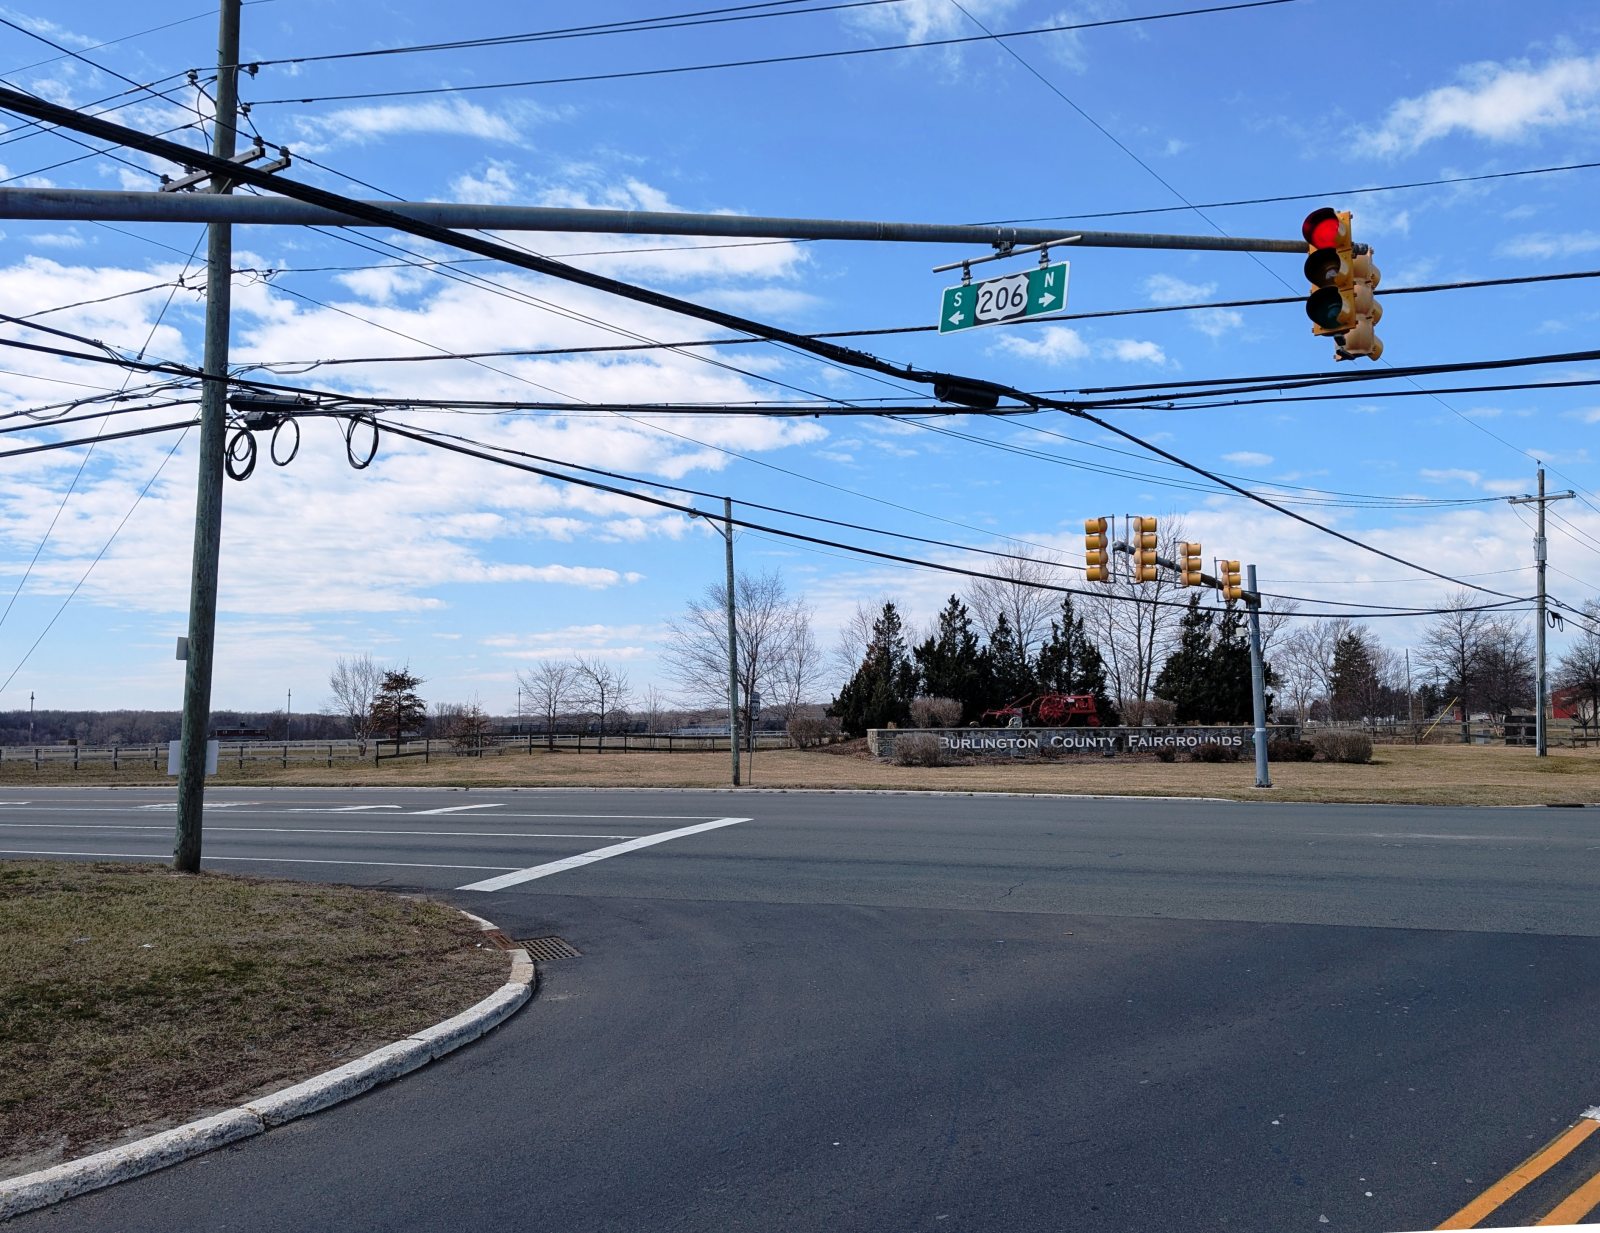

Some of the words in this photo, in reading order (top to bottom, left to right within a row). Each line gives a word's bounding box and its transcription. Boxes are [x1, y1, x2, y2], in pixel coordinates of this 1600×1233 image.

[953, 292, 962, 307] S
[979, 284, 1024, 314] 206
[1044, 271, 1054, 288] N
[939, 737, 1038, 749] BURLINGTON
[1050, 736, 1116, 748] COUNTY
[1128, 735, 1242, 747] FAIRGROUNDS
